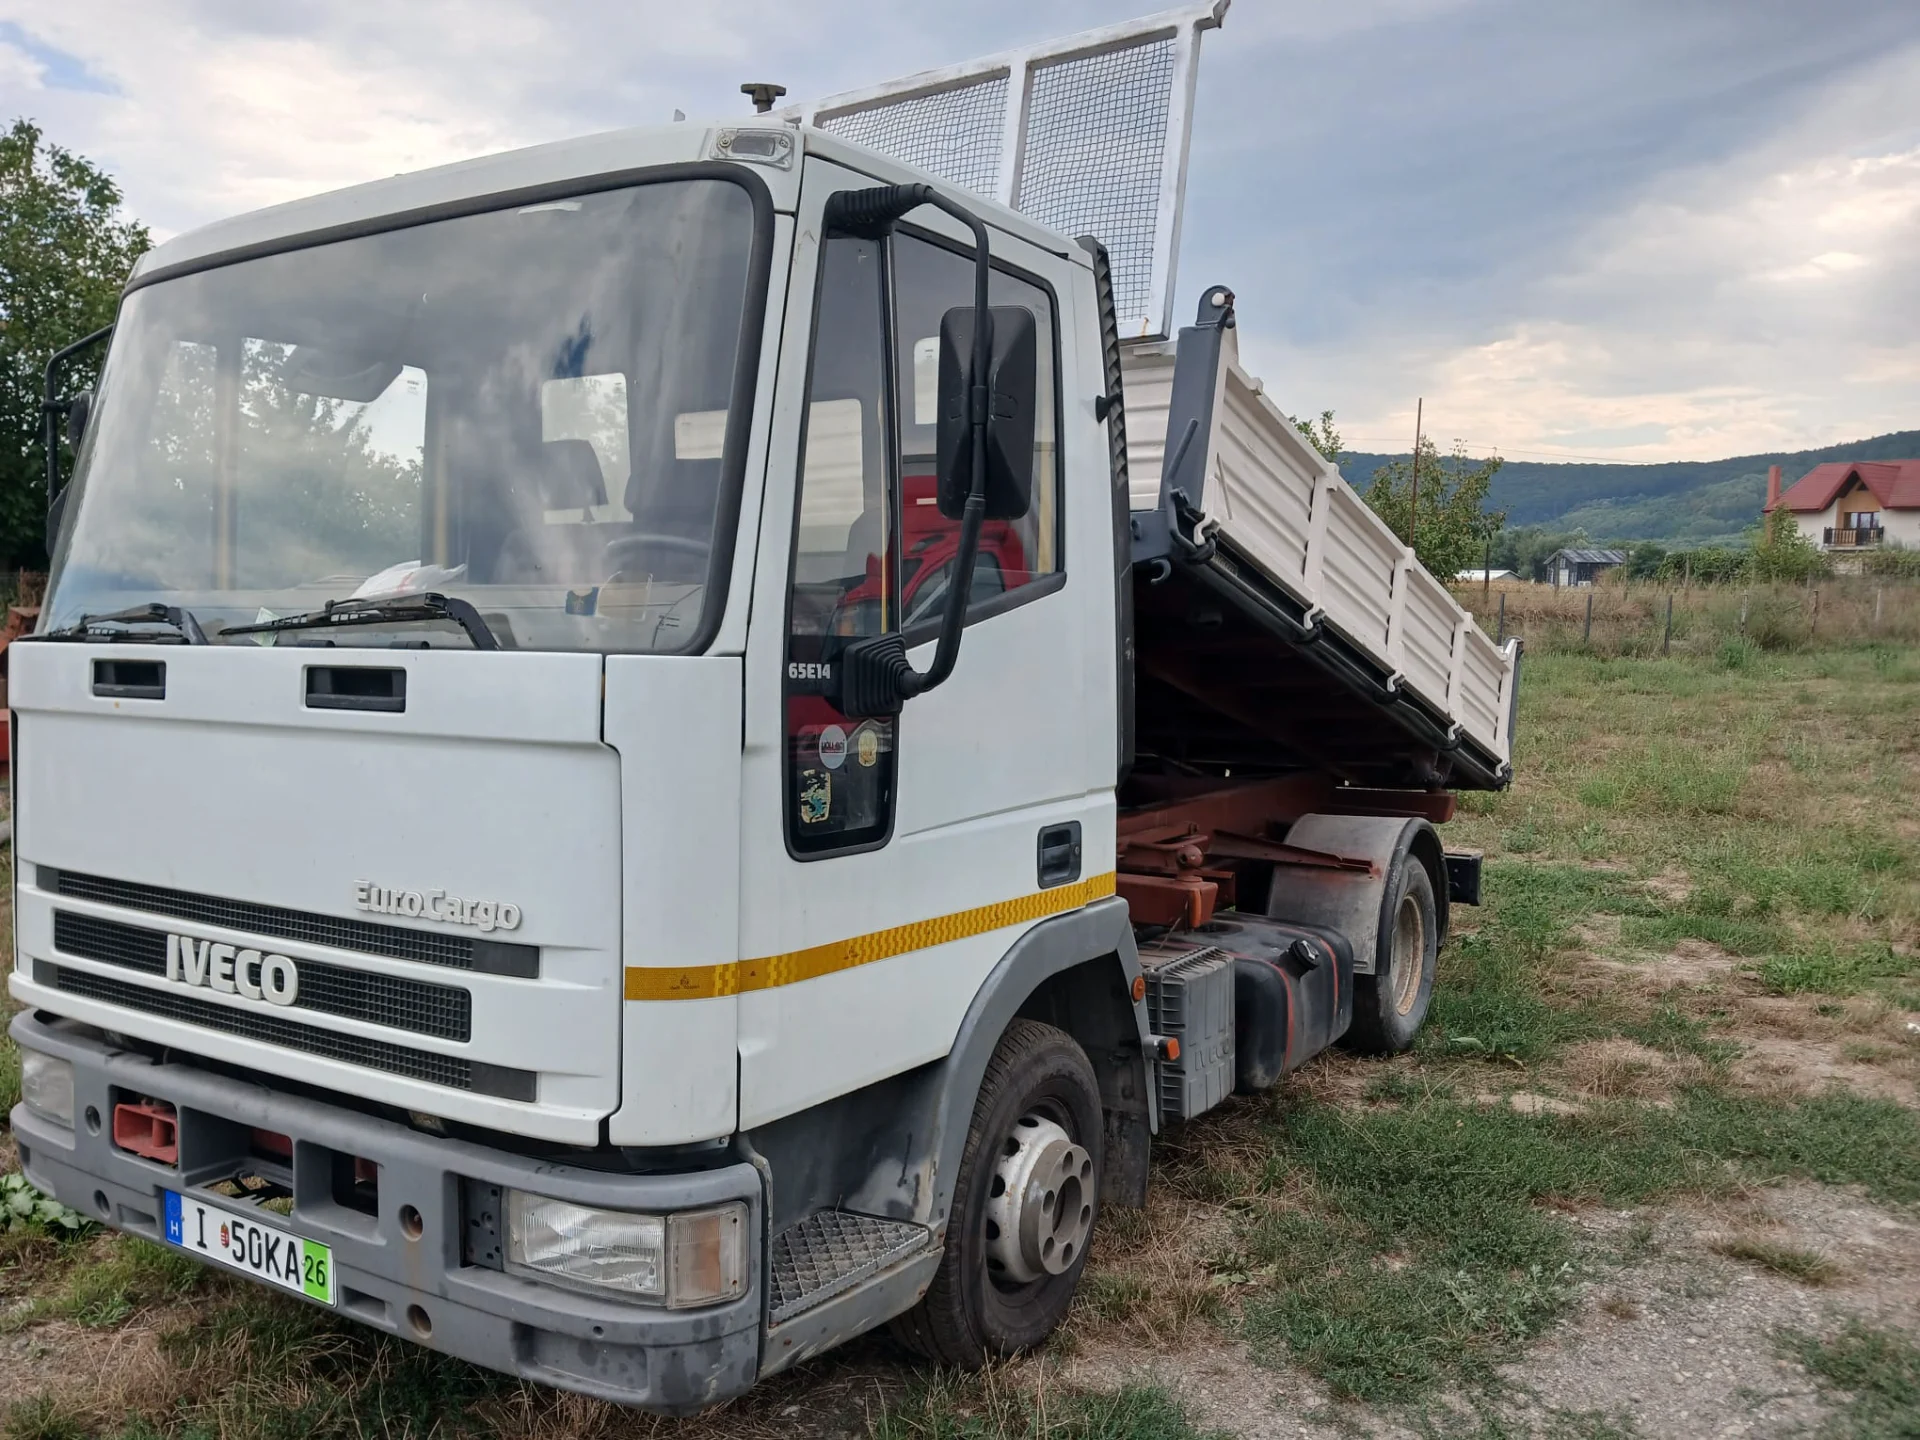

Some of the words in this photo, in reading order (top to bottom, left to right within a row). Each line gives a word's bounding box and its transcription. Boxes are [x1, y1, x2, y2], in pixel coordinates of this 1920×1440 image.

[788, 662, 831, 680] 65E14
[353, 879, 522, 932] EuroCargo
[166, 933, 299, 1006] IVECO
[170, 1220, 179, 1236] H
[304, 1255, 326, 1288] 26
